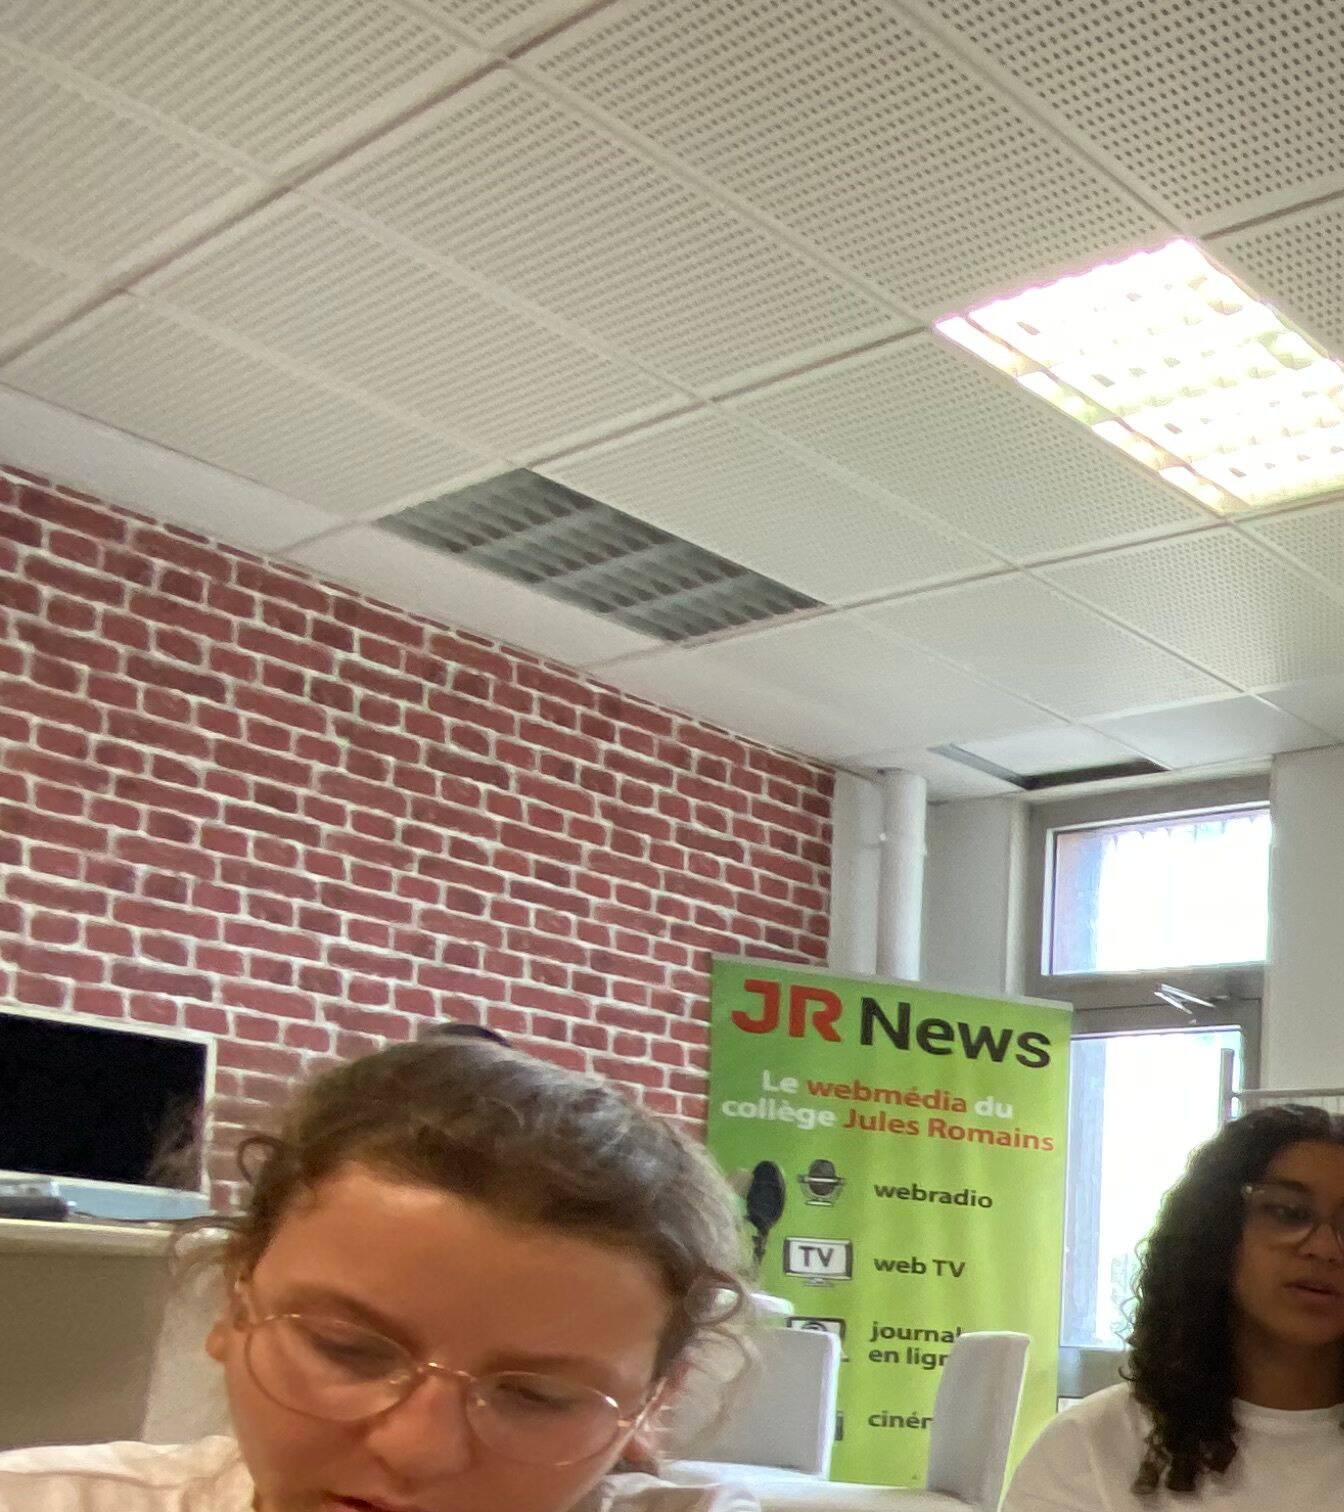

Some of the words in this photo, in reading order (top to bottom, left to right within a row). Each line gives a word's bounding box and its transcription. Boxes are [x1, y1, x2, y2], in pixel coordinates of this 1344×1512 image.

[731, 978, 844, 1043] JR
[859, 996, 1052, 1069] News
[762, 1069, 799, 1094] Le
[806, 1078, 968, 1114] webmédia
[974, 1095, 1014, 1120] du
[721, 1098, 837, 1130] collège
[843, 1108, 920, 1136] Jules
[928, 1118, 1056, 1152] Romains
[873, 1183, 994, 1209] webradio
[798, 1246, 834, 1268] TV
[873, 1256, 927, 1275] web
[932, 1258, 966, 1278] TV
[868, 1348, 900, 1364] en
